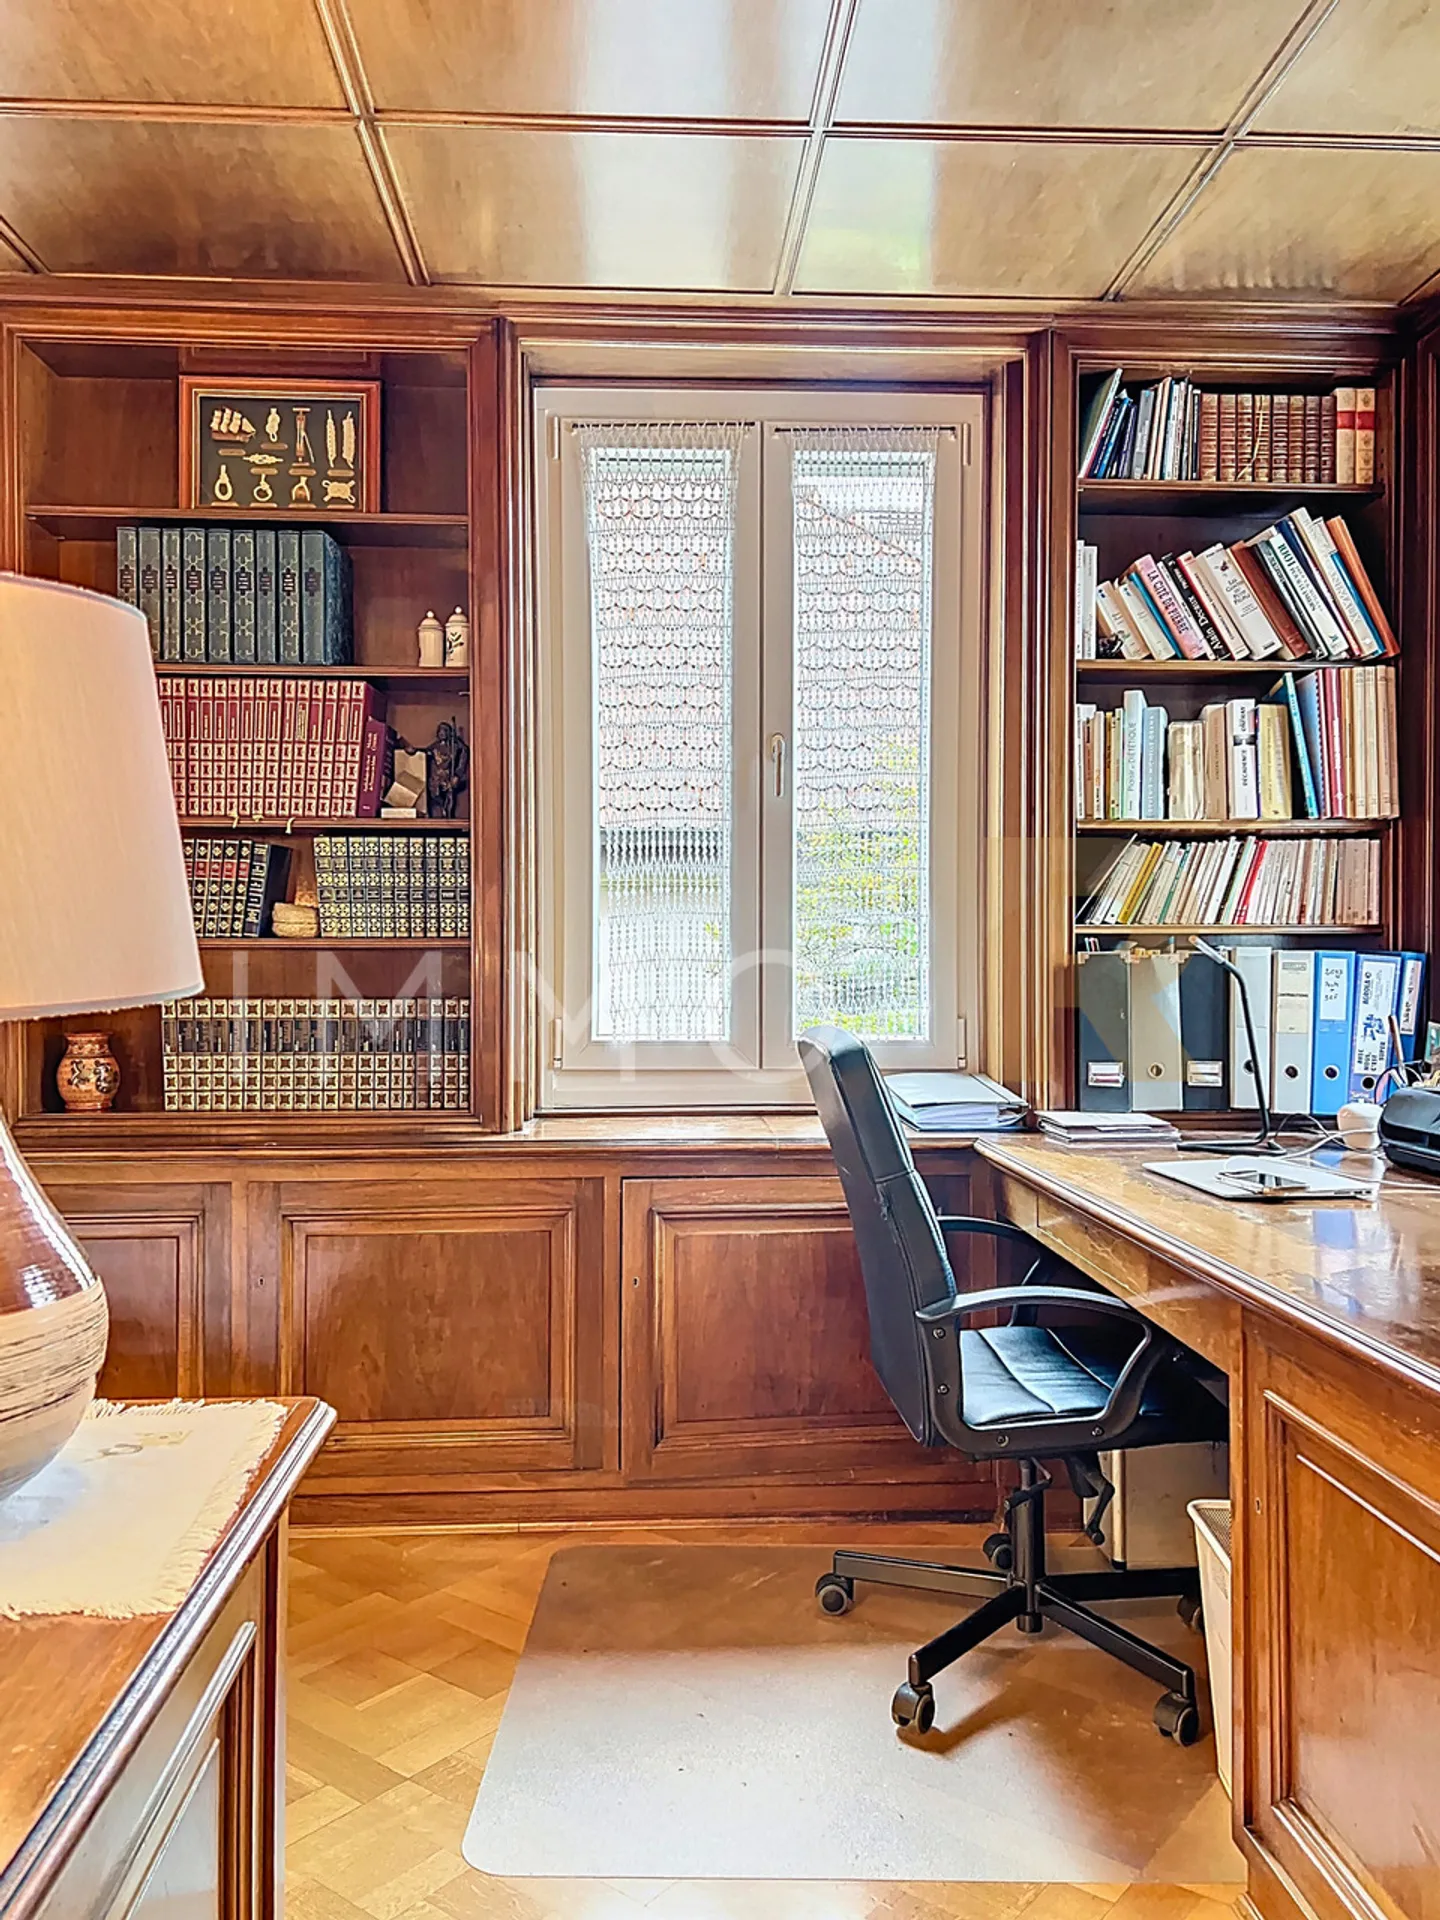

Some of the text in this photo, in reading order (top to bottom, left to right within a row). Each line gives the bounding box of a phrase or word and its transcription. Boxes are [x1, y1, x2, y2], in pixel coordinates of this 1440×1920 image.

[1146, 569, 1160, 582] LA
[1161, 596, 1175, 610] DE
[1187, 595, 1208, 626] Decaux
[1203, 626, 1222, 651] Alain
